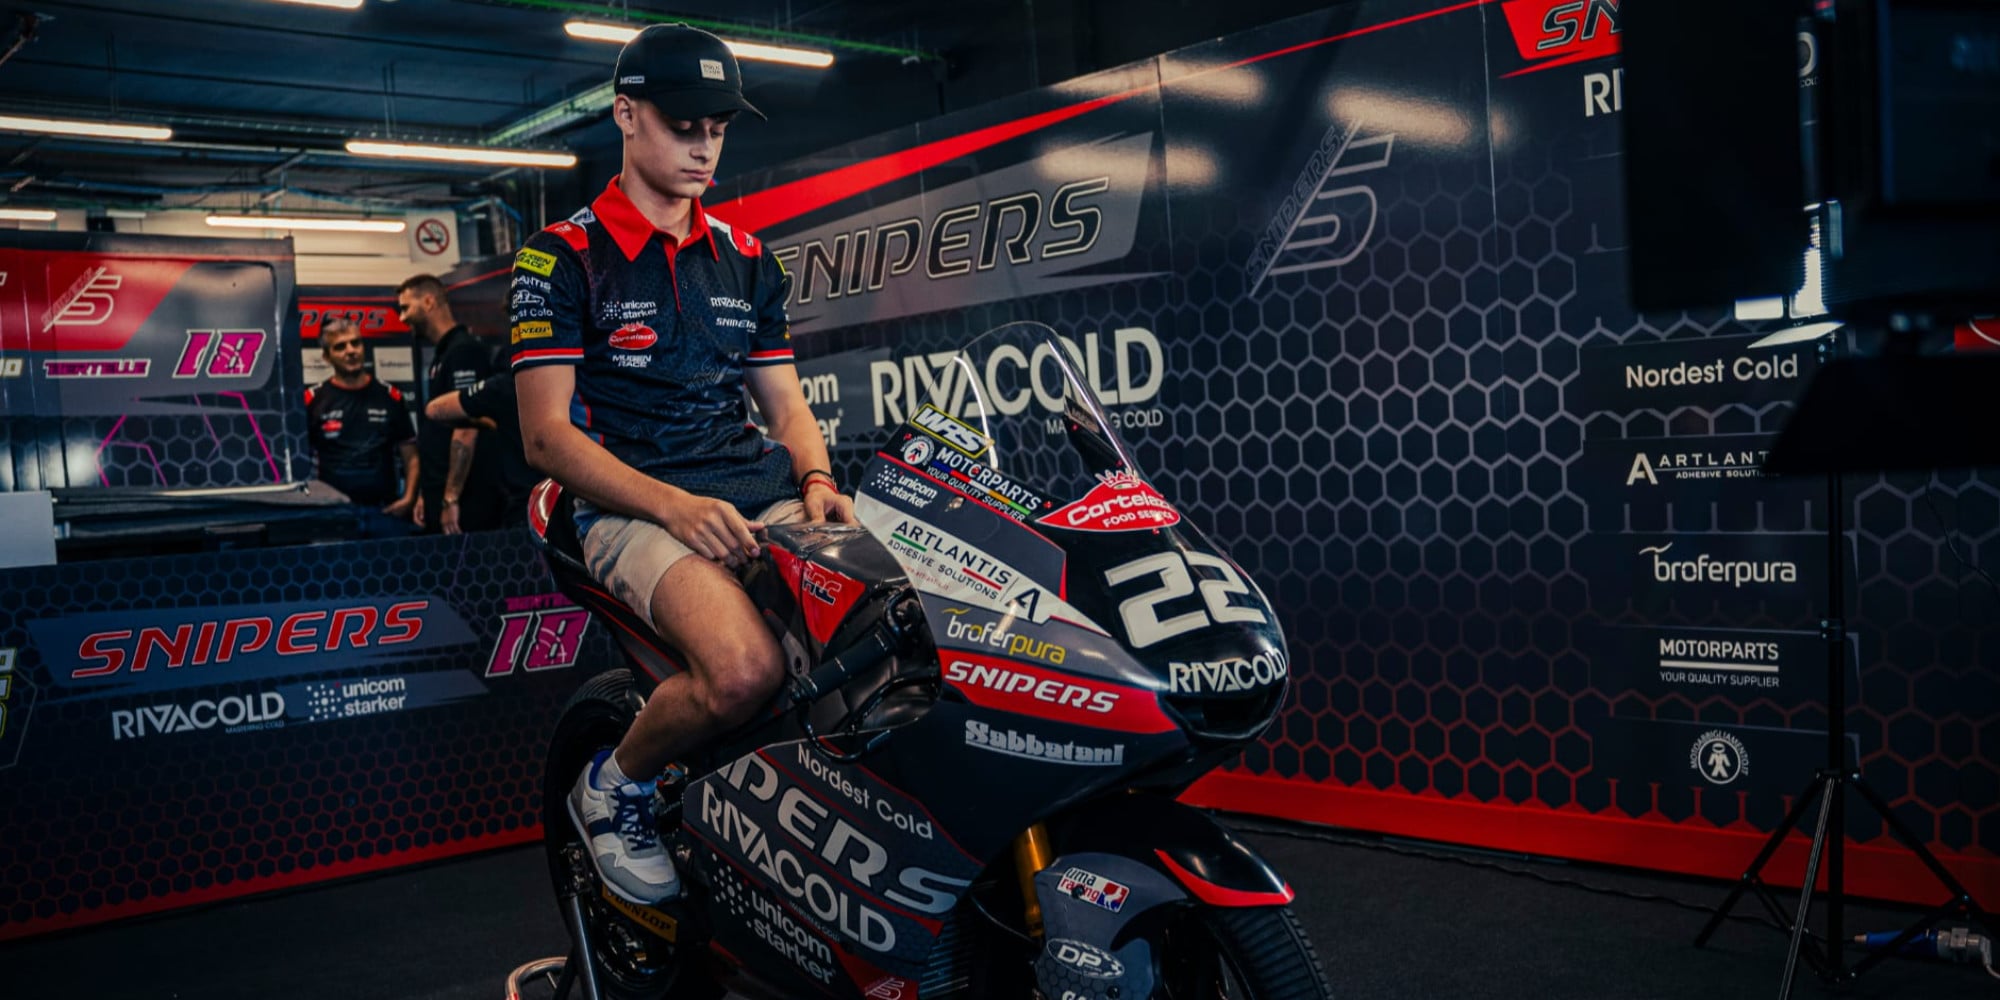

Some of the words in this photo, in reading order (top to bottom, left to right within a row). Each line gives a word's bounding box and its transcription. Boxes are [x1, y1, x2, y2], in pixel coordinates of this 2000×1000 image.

[772, 176, 1109, 309] SNIPERS
[299, 309, 387, 329] PERS
[620, 300, 656, 310] unicom
[622, 308, 658, 319] starker
[172, 329, 266, 378] 18
[612, 354, 652, 362] MUGEN
[1626, 358, 1725, 389] Nordest
[1733, 353, 1798, 381] Cold
[870, 327, 1164, 427] RIVACOLD
[914, 406, 985, 452] WRS
[1124, 409, 1164, 429] COLD
[935, 446, 1042, 511] MOTORPARTS
[1659, 451, 1771, 467] ARTLANT
[1676, 470, 1721, 479] ADHESIVE
[1726, 469, 1781, 478] SOLUTI
[890, 485, 930, 509] starker
[898, 474, 938, 499] unicom
[926, 465, 948, 483] YOUR
[948, 477, 985, 500] QUALITY
[982, 495, 1026, 522] SUPPLIER
[1102, 512, 1137, 528] FOOD
[887, 539, 935, 567] ADHESIVE
[938, 564, 999, 600] SOLUTIONS
[895, 520, 1012, 585] ARTLANTIS
[1654, 554, 1797, 588] broferpura
[1104, 551, 1268, 649] 22
[71, 600, 429, 679] SNIPERS
[484, 606, 592, 678] 18
[946, 614, 1067, 665] broferpura
[1659, 638, 1779, 661] MOTORPARTS
[342, 677, 406, 698] unicom
[945, 660, 1121, 713] SNIPERS
[1168, 647, 1288, 694] RIVACOLD
[1660, 671, 1687, 684] YOUR
[1688, 672, 1728, 686] QUALITY
[1730, 674, 1780, 688] SUPPLIER
[112, 691, 285, 741] RIVACOLD
[344, 693, 406, 717] starker
[797, 743, 870, 809] Nordest
[876, 798, 934, 840] Cold
[718, 752, 972, 916] PERS
[701, 780, 896, 952] RIVACOLD
[1060, 878, 1100, 902] raing
[751, 889, 833, 965] unicom
[753, 917, 835, 985] starker
[1057, 944, 1102, 967] DP
